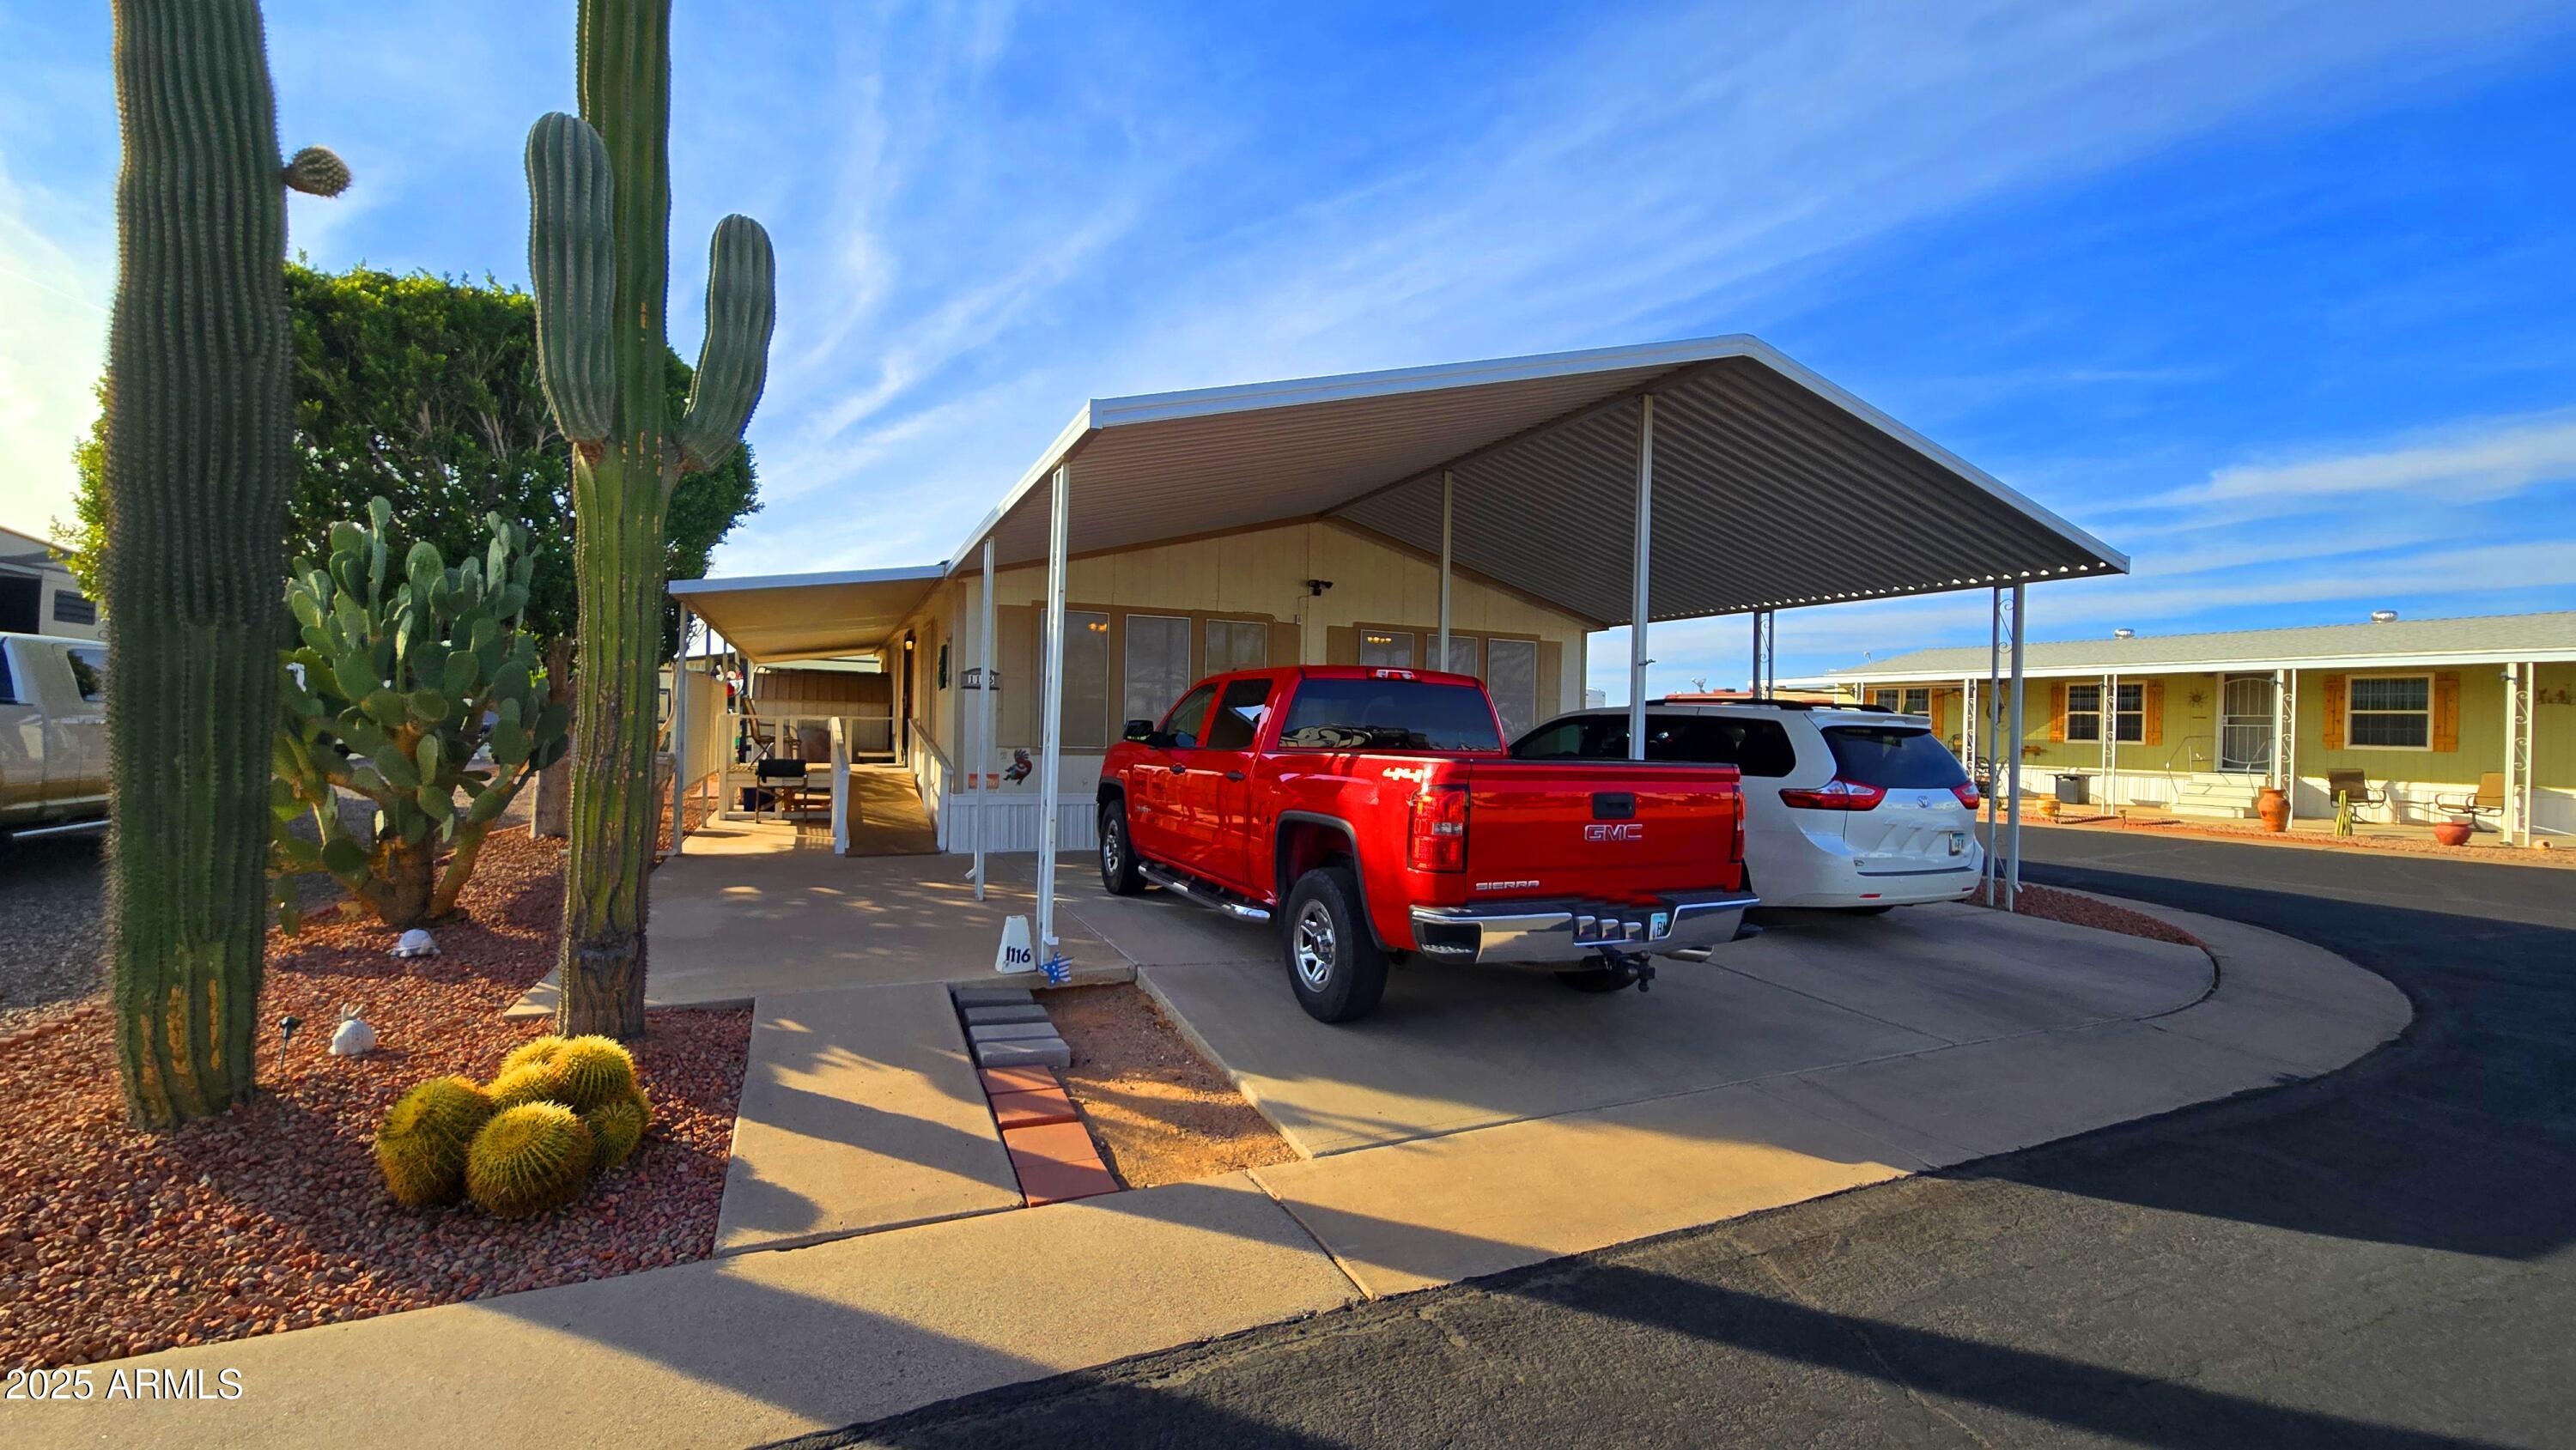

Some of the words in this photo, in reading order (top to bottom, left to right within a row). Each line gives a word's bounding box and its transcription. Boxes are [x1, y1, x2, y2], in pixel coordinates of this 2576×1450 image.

[969, 674, 994, 685] 116
[1584, 824, 1643, 841] GMC
[1476, 880, 1540, 890] SIERRA
[1006, 945, 1030, 963] 1116
